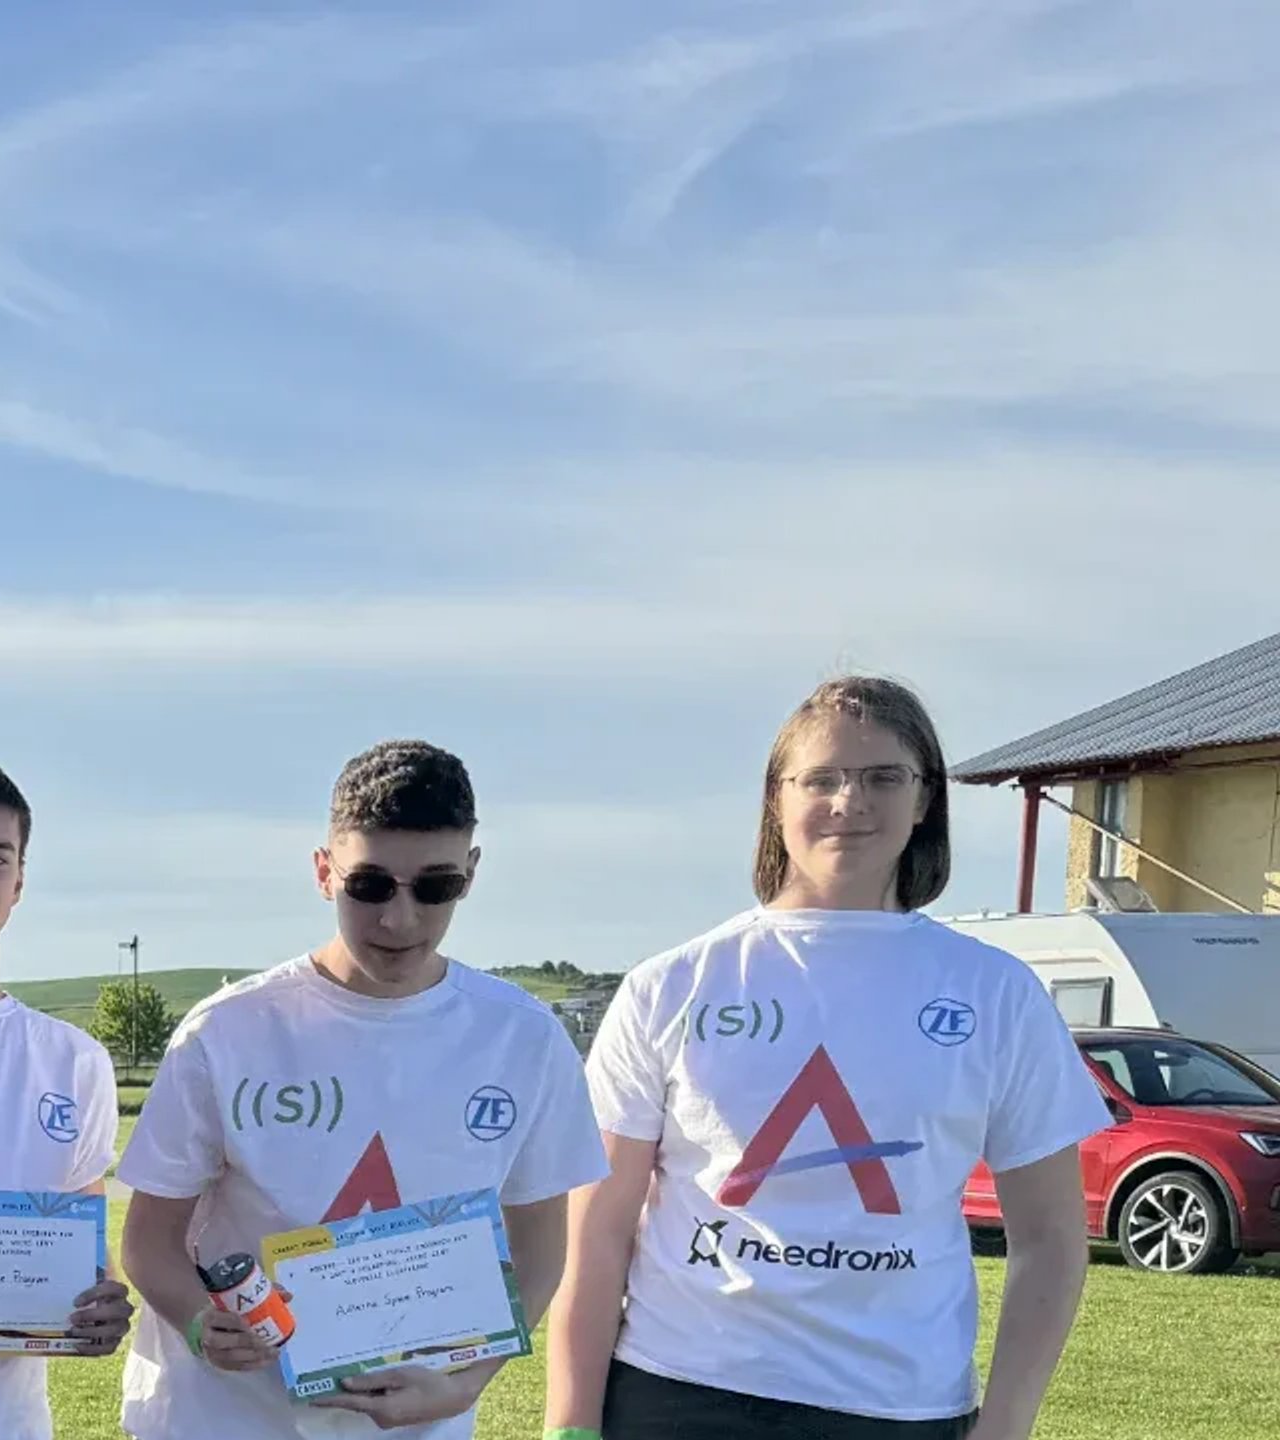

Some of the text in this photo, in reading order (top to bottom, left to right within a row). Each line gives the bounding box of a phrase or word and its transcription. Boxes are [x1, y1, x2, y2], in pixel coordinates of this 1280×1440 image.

[926, 1004, 973, 1038] ZF
[469, 1095, 514, 1131] ZF
[737, 1237, 917, 1272] needronix
